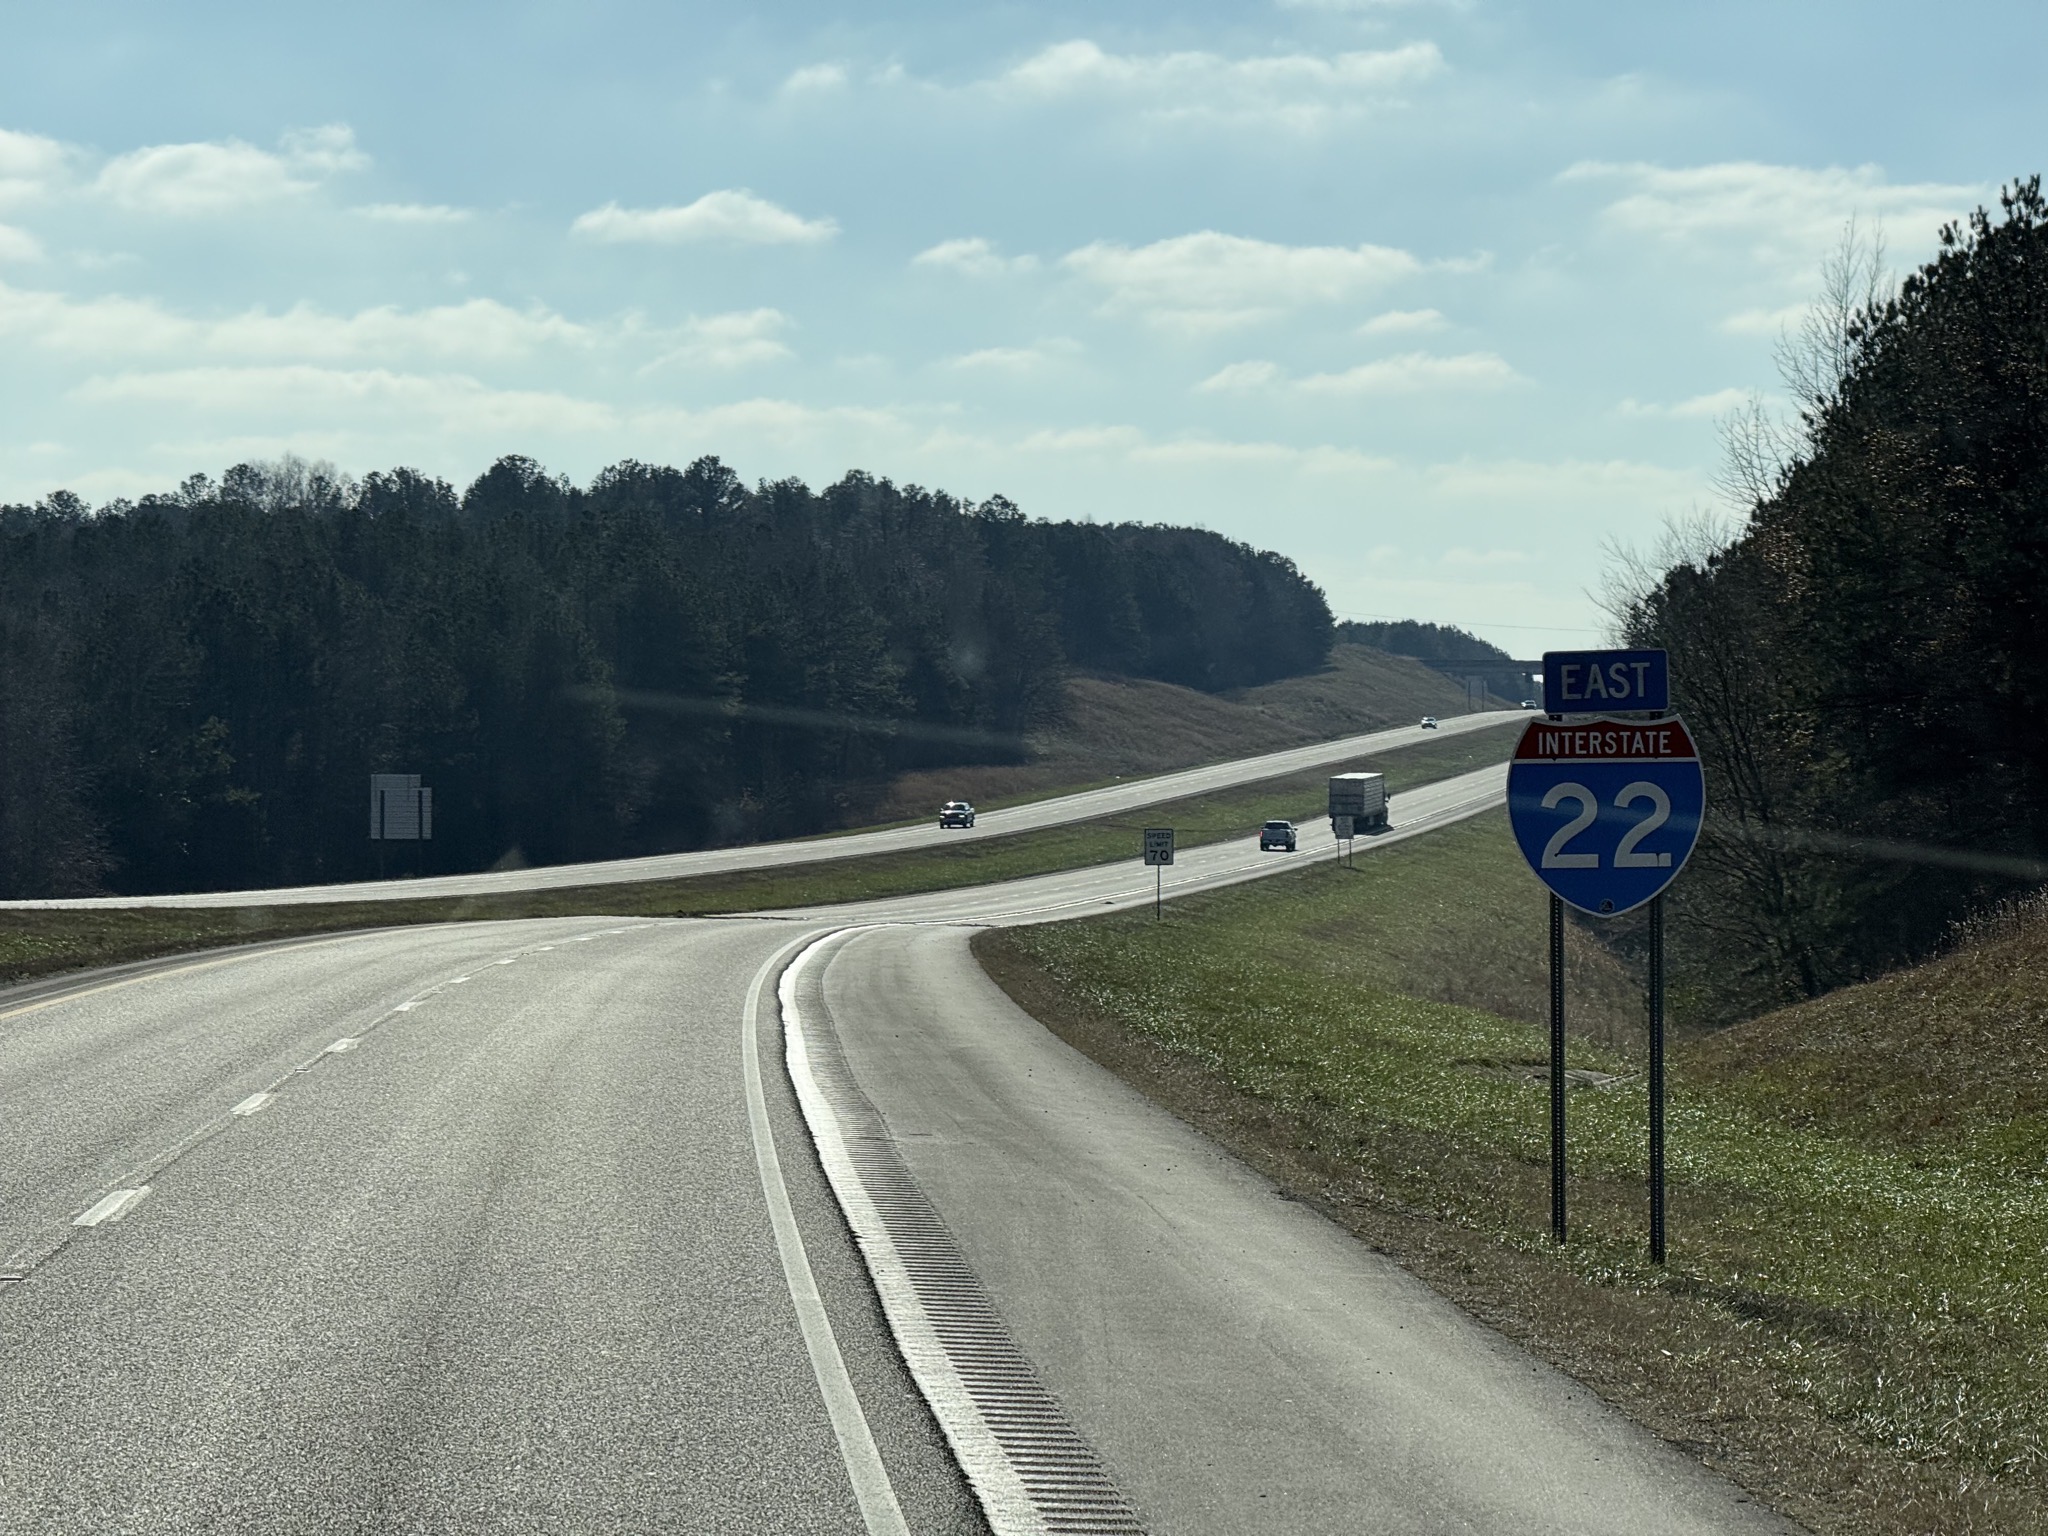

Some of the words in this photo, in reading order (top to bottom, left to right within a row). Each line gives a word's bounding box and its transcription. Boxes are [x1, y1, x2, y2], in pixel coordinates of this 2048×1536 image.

[1561, 662, 1650, 700] EAST
[1538, 731, 1672, 754] INTERSTATE
[1541, 782, 1671, 868] 22
[1150, 850, 1169, 860] 70
